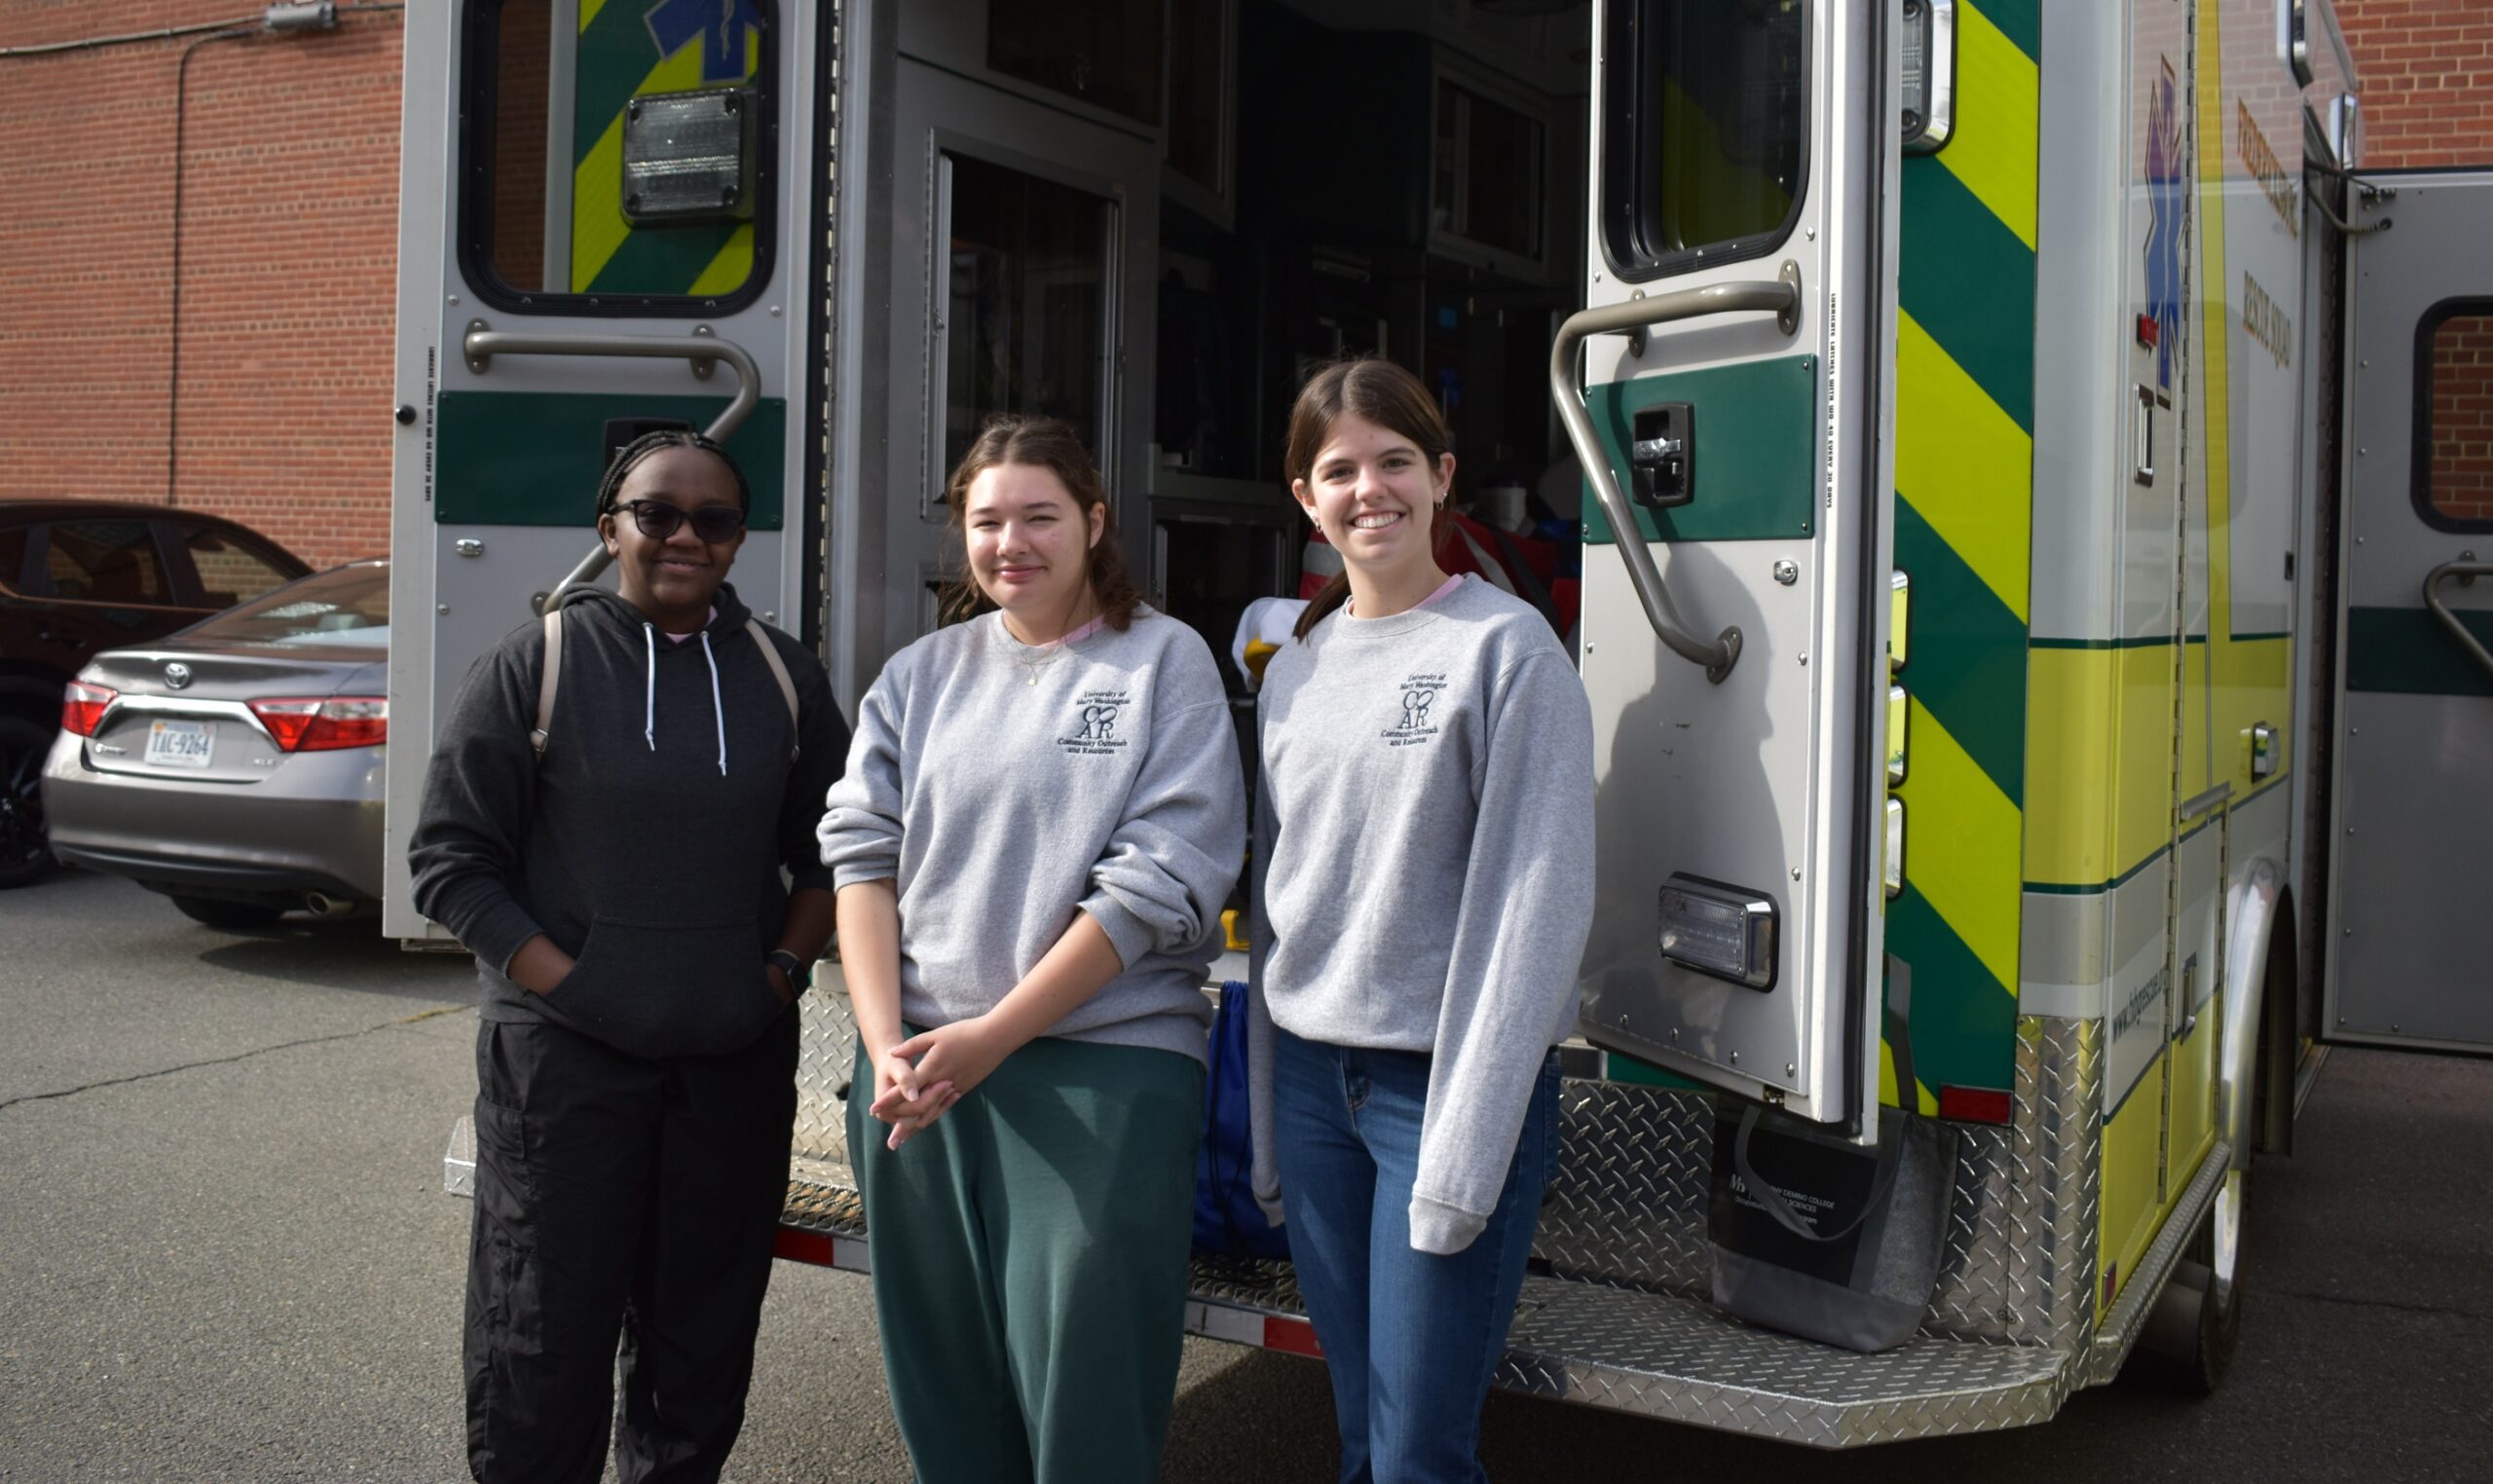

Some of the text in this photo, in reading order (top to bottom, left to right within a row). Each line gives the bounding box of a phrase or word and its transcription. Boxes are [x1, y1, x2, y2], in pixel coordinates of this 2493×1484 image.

[1095, 697, 1131, 706] Washington
[1058, 738, 1096, 747] Community
[1788, 1199, 1817, 1213] SCIENCES
[1807, 1195, 1836, 1209] COLLEGE
